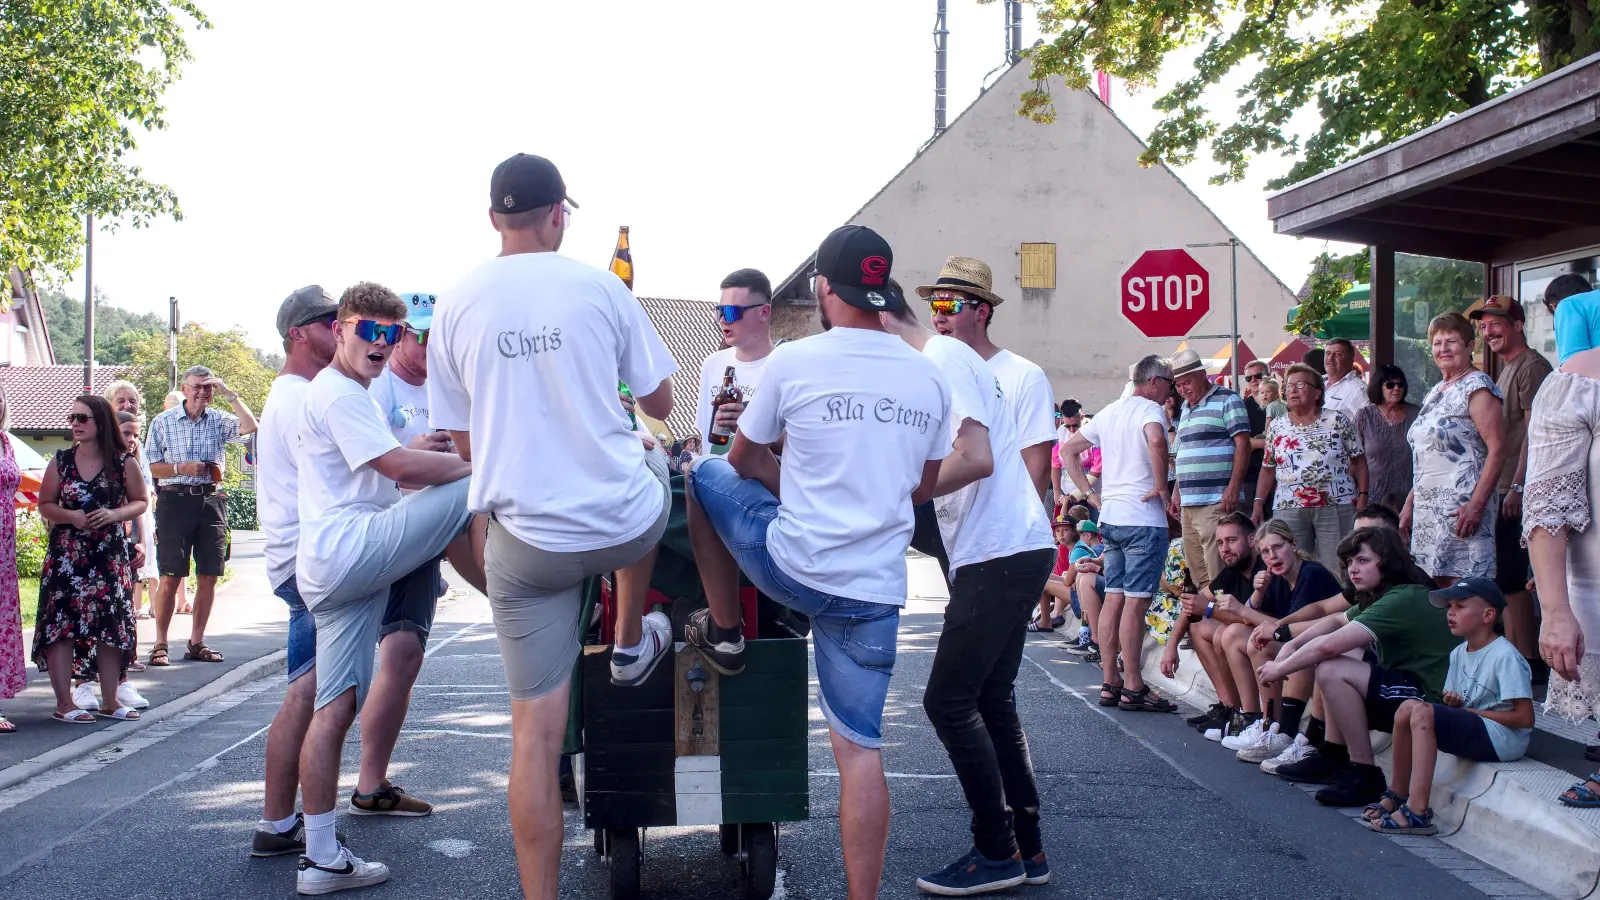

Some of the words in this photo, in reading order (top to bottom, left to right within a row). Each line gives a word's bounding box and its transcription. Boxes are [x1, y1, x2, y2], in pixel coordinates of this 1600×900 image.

[861, 255, 888, 277] G
[1127, 274, 1203, 312] STOP
[497, 325, 562, 363] Chris
[821, 395, 865, 421] Kla
[874, 397, 931, 435] Stenz
